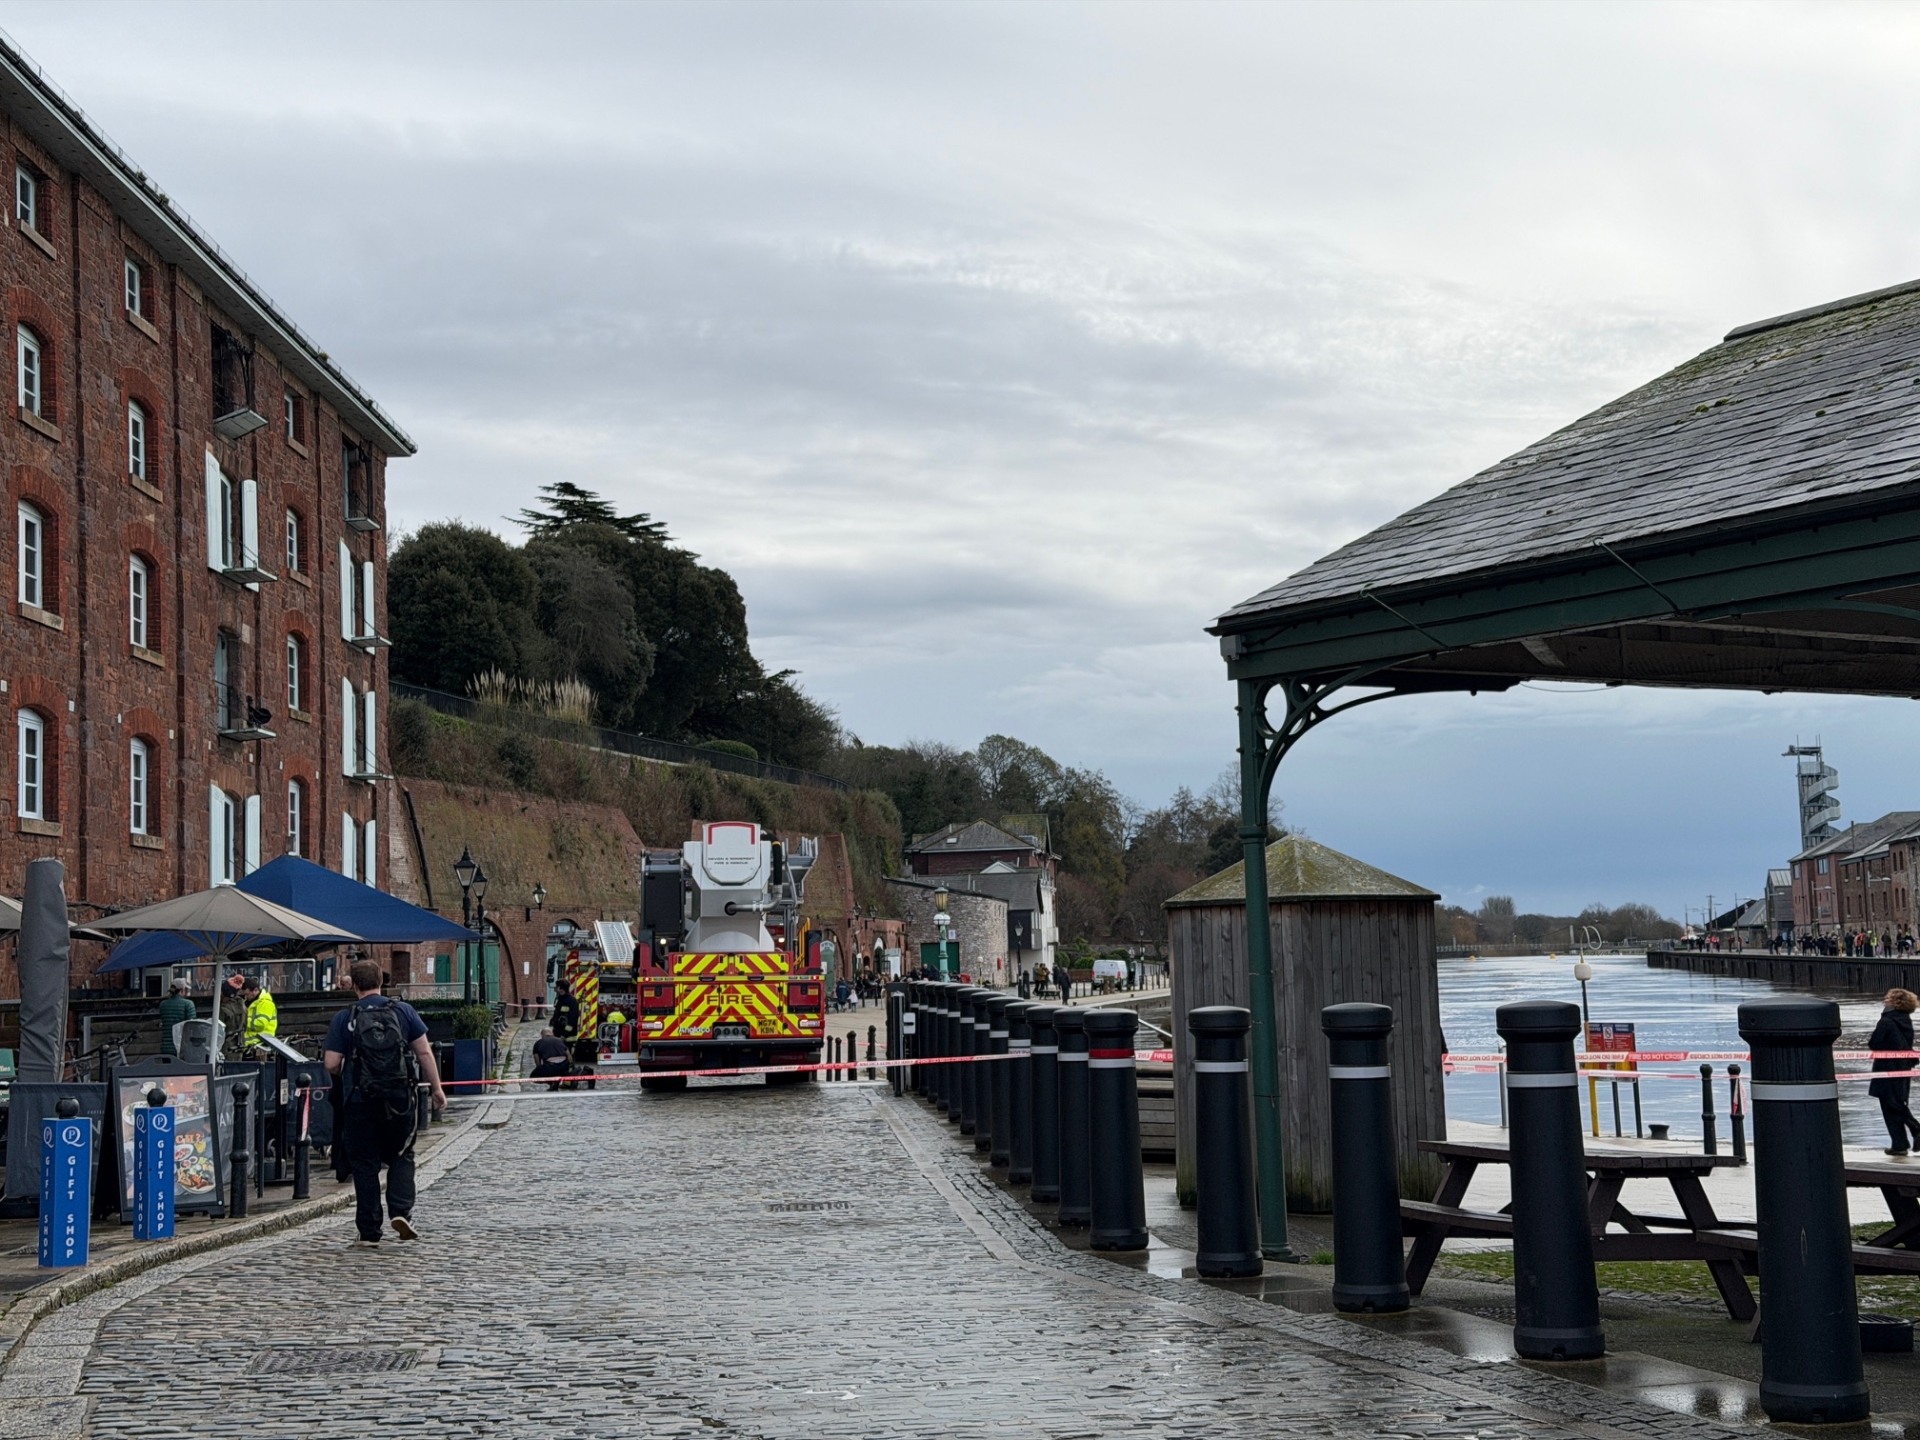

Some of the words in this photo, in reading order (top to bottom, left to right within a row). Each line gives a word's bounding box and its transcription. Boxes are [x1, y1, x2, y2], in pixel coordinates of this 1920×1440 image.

[240, 967, 255, 975] THE
[706, 994, 754, 1005] FIRE
[1642, 1053, 1651, 1061] DO
[1651, 1053, 1664, 1061] NOT
[157, 1139, 165, 1180] GIFT
[67, 1155, 76, 1200] GIFT
[65, 1213, 75, 1259] SHOP
